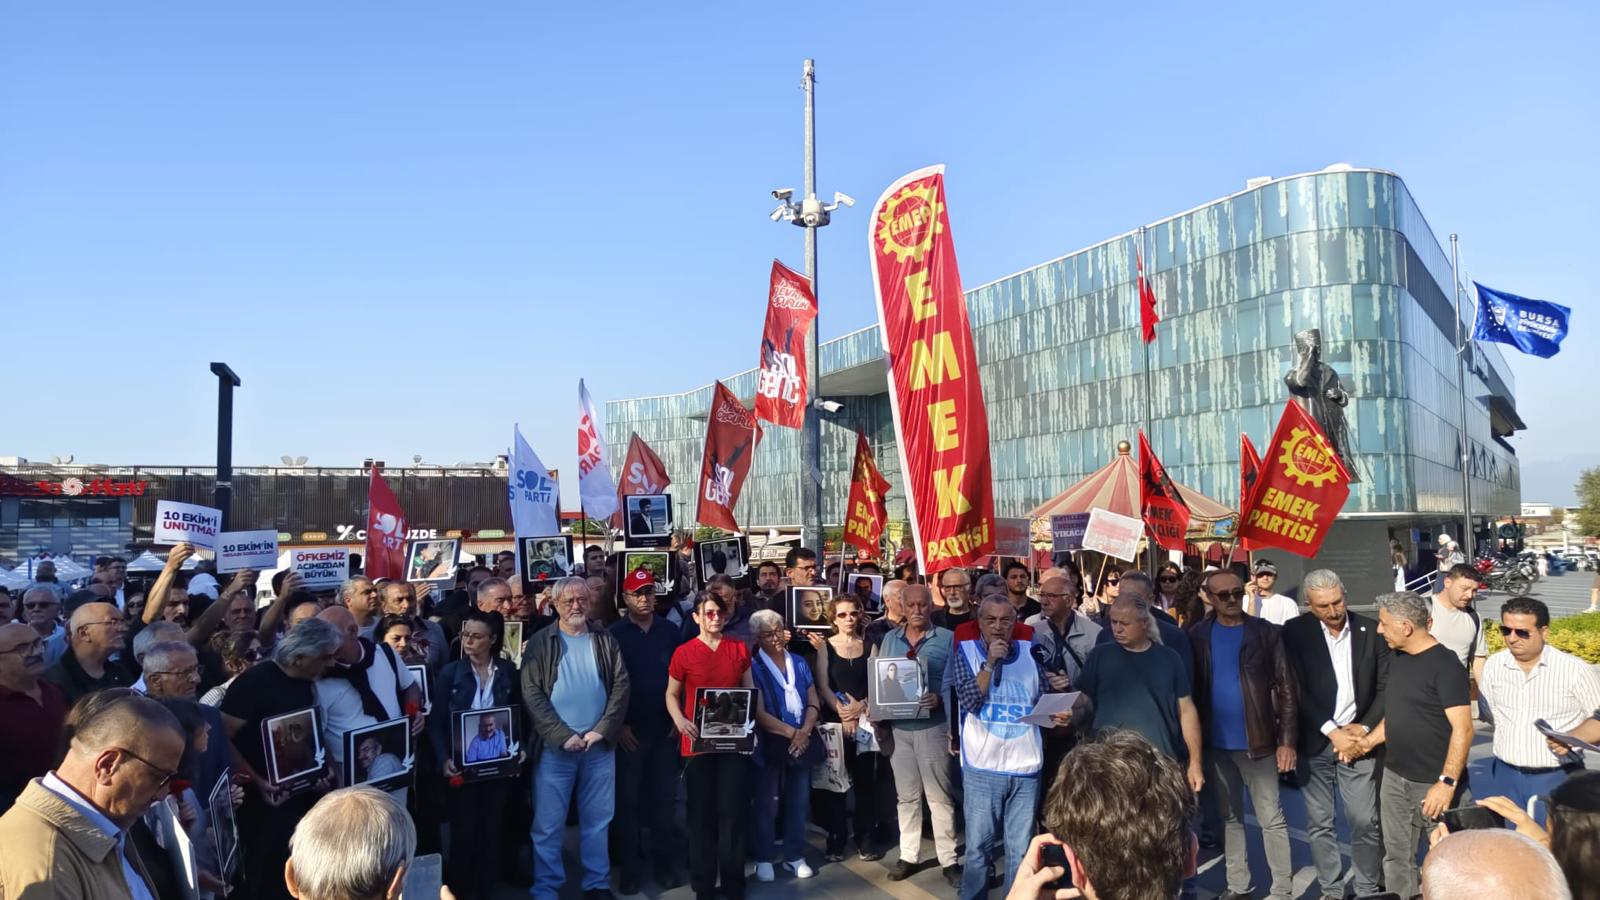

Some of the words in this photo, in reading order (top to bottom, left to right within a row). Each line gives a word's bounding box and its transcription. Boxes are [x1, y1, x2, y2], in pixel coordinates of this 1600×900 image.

[891, 206, 929, 236] EMEP
[1519, 310, 1560, 328] BURSA
[771, 350, 796, 377] SOL
[904, 267, 972, 519] EMEK
[516, 469, 553, 491] SOL
[524, 490, 552, 503] PARTİ
[1261, 487, 1320, 520] EMEK
[163, 511, 180, 521] 10
[182, 512, 217, 527] EKİM'İ
[1147, 505, 1174, 520] MEK
[163, 521, 216, 537] UNUTMA!
[1247, 509, 1319, 544] PARTİSİ
[223, 544, 235, 553] 10
[239, 540, 274, 552] EKİM'İN
[927, 518, 990, 563] PARTİSİ
[296, 549, 345, 562] ÖFKEMİZ
[296, 561, 345, 571] ACIMIZDAN
[304, 569, 337, 579] BÜYÜK!
